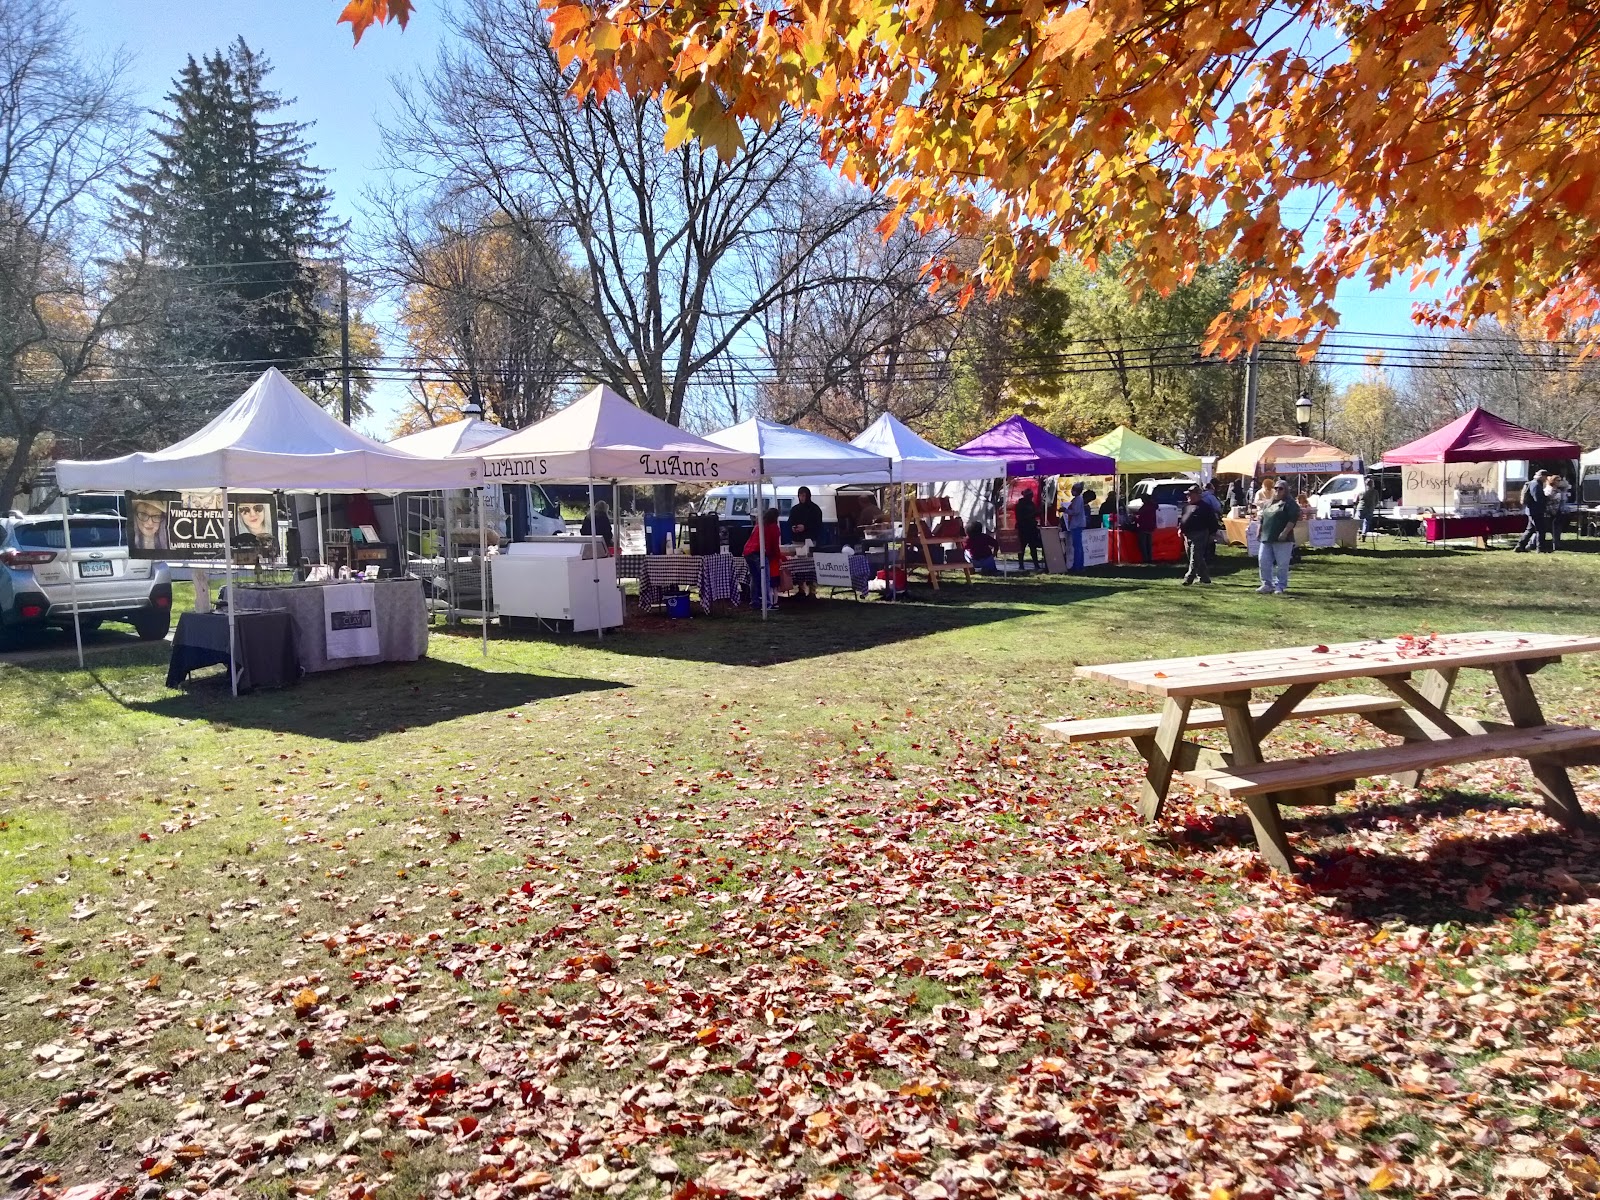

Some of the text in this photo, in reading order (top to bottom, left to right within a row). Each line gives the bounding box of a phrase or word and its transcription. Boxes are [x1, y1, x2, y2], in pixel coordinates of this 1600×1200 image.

[483, 456, 547, 477] LuAnn's
[640, 454, 719, 477] LuAnn's
[1406, 470, 1453, 490] Blessed
[170, 509, 203, 518] VINTAGE
[173, 516, 231, 540] CLAY
[170, 541, 191, 549] LAURIE
[816, 562, 849, 572] LuAnn's
